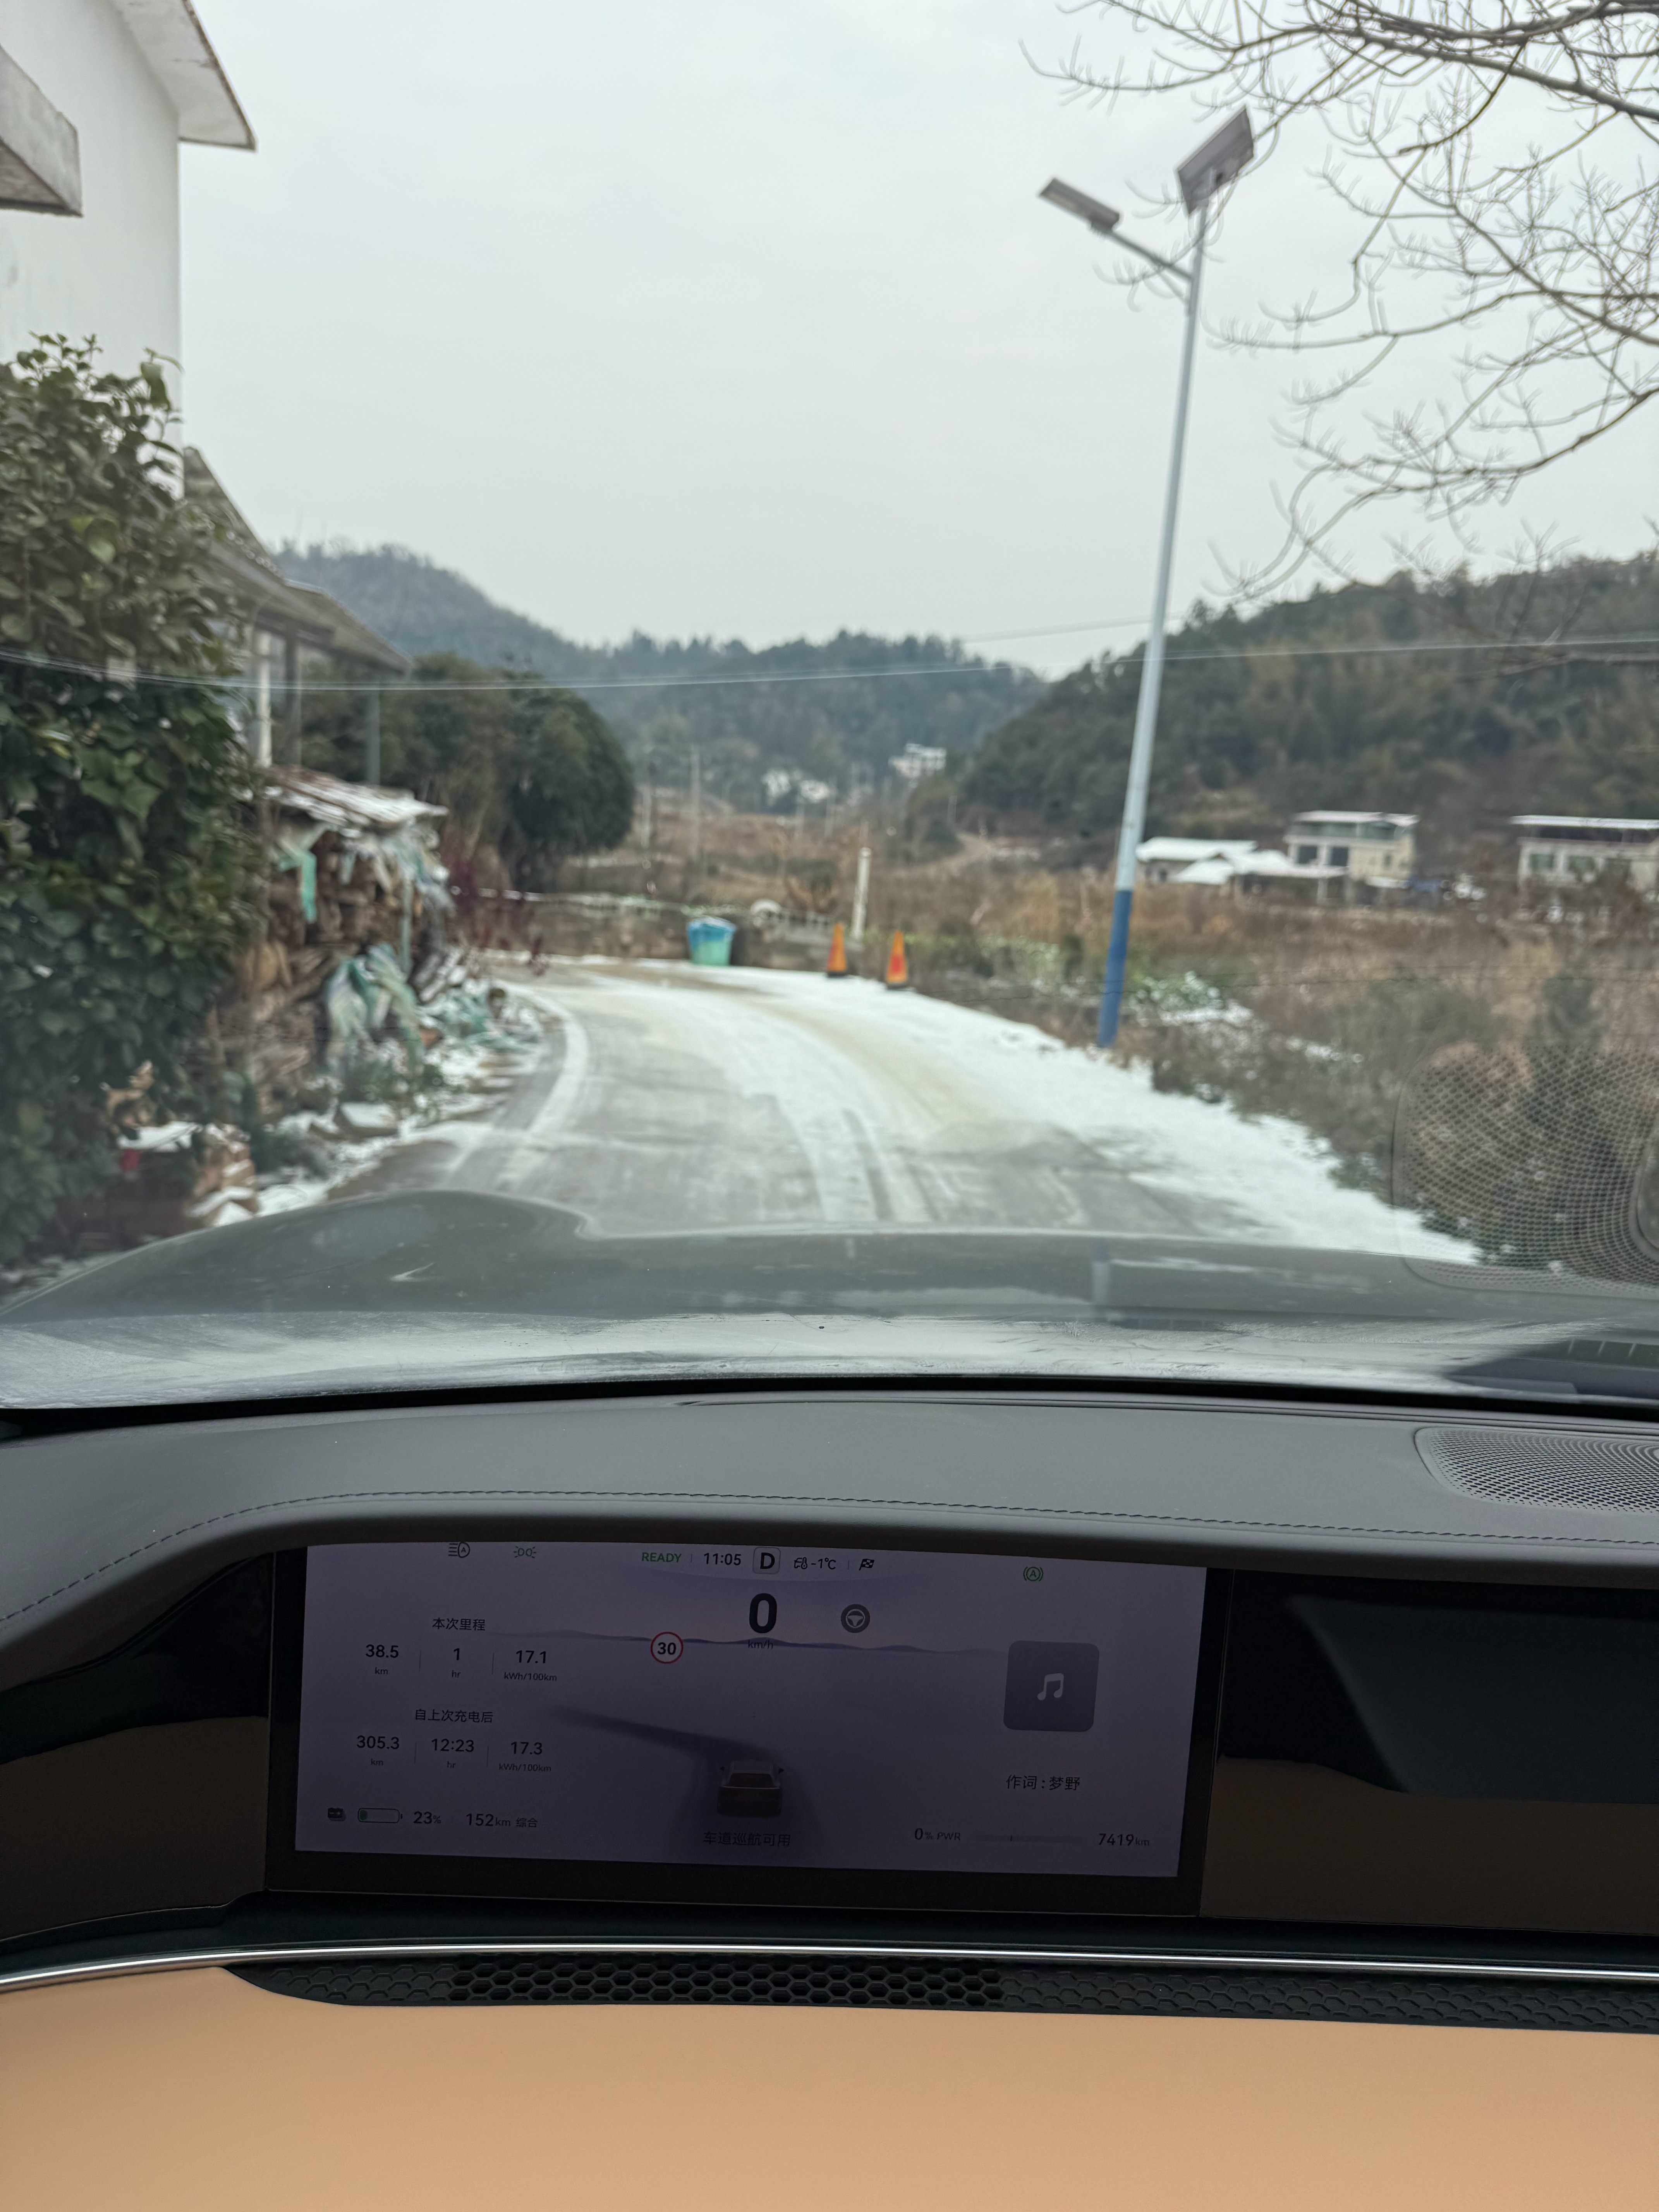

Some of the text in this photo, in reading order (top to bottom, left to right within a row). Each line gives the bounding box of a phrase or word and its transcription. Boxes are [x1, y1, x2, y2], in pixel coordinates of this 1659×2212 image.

[642, 1552, 682, 1563] READY
[704, 1553, 741, 1566] 11:05
[760, 1552, 775, 1570] D
[749, 1593, 777, 1634] 0
[432, 1617, 485, 1631] 本次里程
[366, 1644, 399, 1658] 38.5
[657, 1642, 677, 1655] 30
[747, 1639, 773, 1649] km/h
[453, 1648, 460, 1661] 1
[516, 1650, 546, 1664] 17.1
[504, 1672, 557, 1681] kWh/100km
[415, 1709, 493, 1723] 自上次充电后
[357, 1735, 400, 1750] 305.3
[431, 1738, 474, 1752] 12:23
[511, 1741, 543, 1755] 17.3
[499, 1763, 551, 1772] kWh/100km
[413, 1811, 441, 1824] 23%
[466, 1813, 538, 1828] 152km 综合
[703, 1831, 791, 1847] 车道巡航可用
[937, 1832, 960, 1841] PWR
[1099, 1833, 1149, 1846] 7419km
